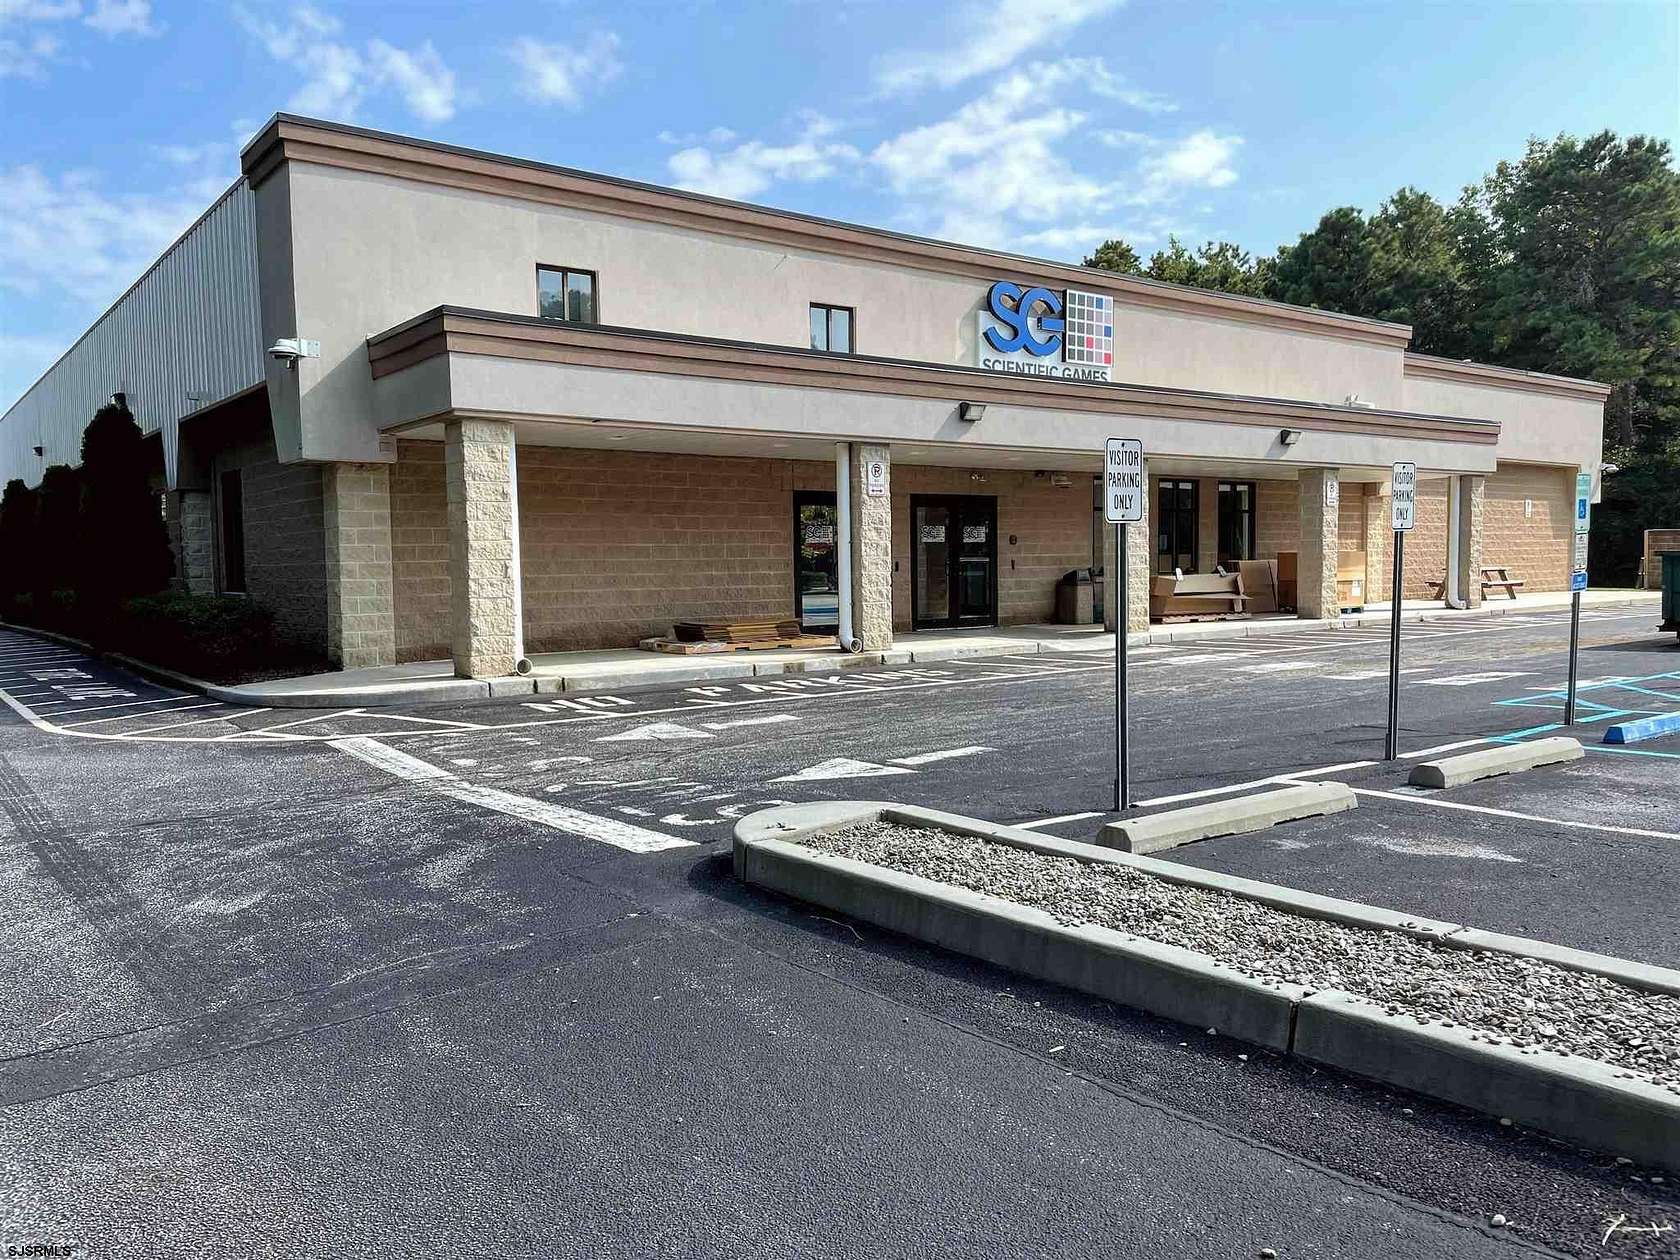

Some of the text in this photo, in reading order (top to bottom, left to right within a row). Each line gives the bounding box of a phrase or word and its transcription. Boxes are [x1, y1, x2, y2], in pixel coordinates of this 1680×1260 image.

[983, 281, 1066, 357] SG
[982, 358, 1108, 381] SCIENTIFIC GAMES
[1109, 450, 1139, 466] VISITOR
[1108, 472, 1140, 488] PARKING
[1395, 472, 1413, 485] VISITOR
[1114, 494, 1134, 509] ONLY
[1393, 490, 1413, 502] PARKING
[1396, 508, 1409, 520] ONLY
[684, 668, 956, 697] PARKING
